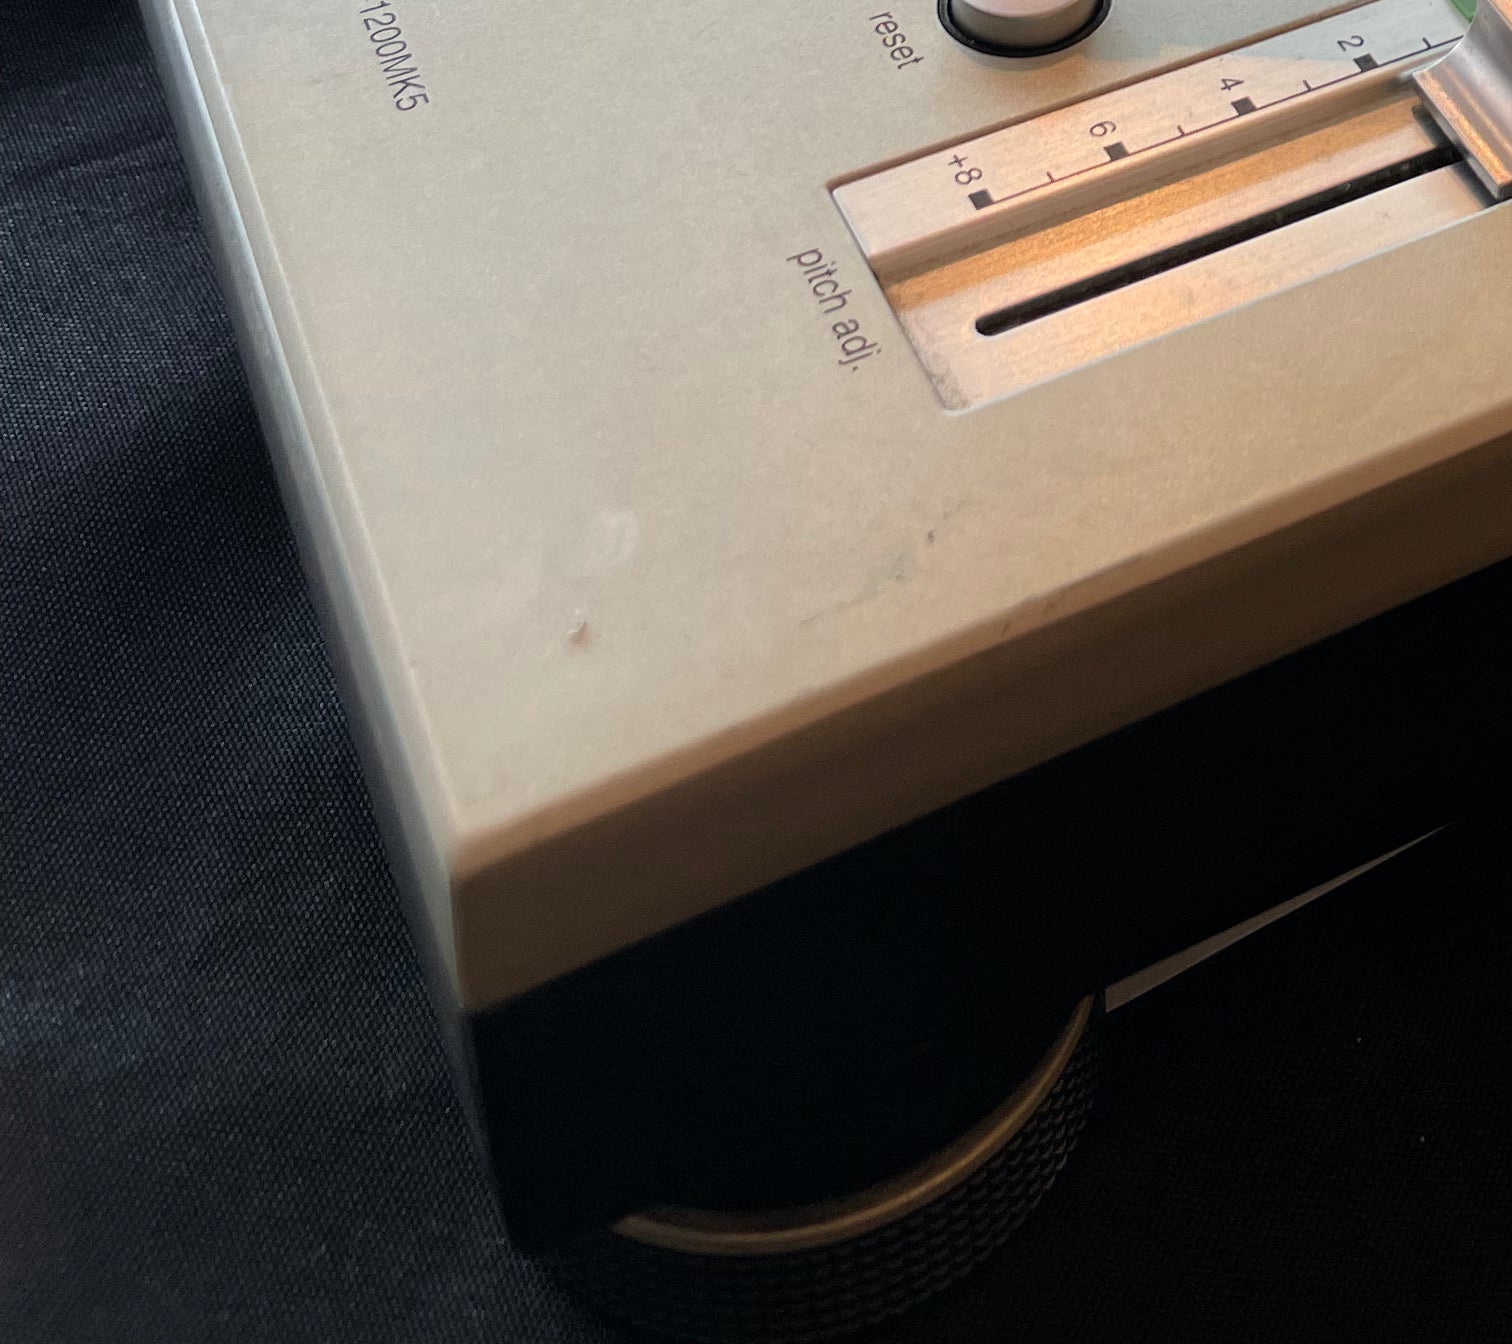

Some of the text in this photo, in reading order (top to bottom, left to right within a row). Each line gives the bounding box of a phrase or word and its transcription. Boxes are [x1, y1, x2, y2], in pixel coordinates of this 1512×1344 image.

[868, 10, 925, 70] reset
[1337, 34, 1365, 53] 2
[1220, 76, 1245, 92] 4
[1089, 119, 1117, 138] 6
[786, 247, 882, 373] pitch adj.
